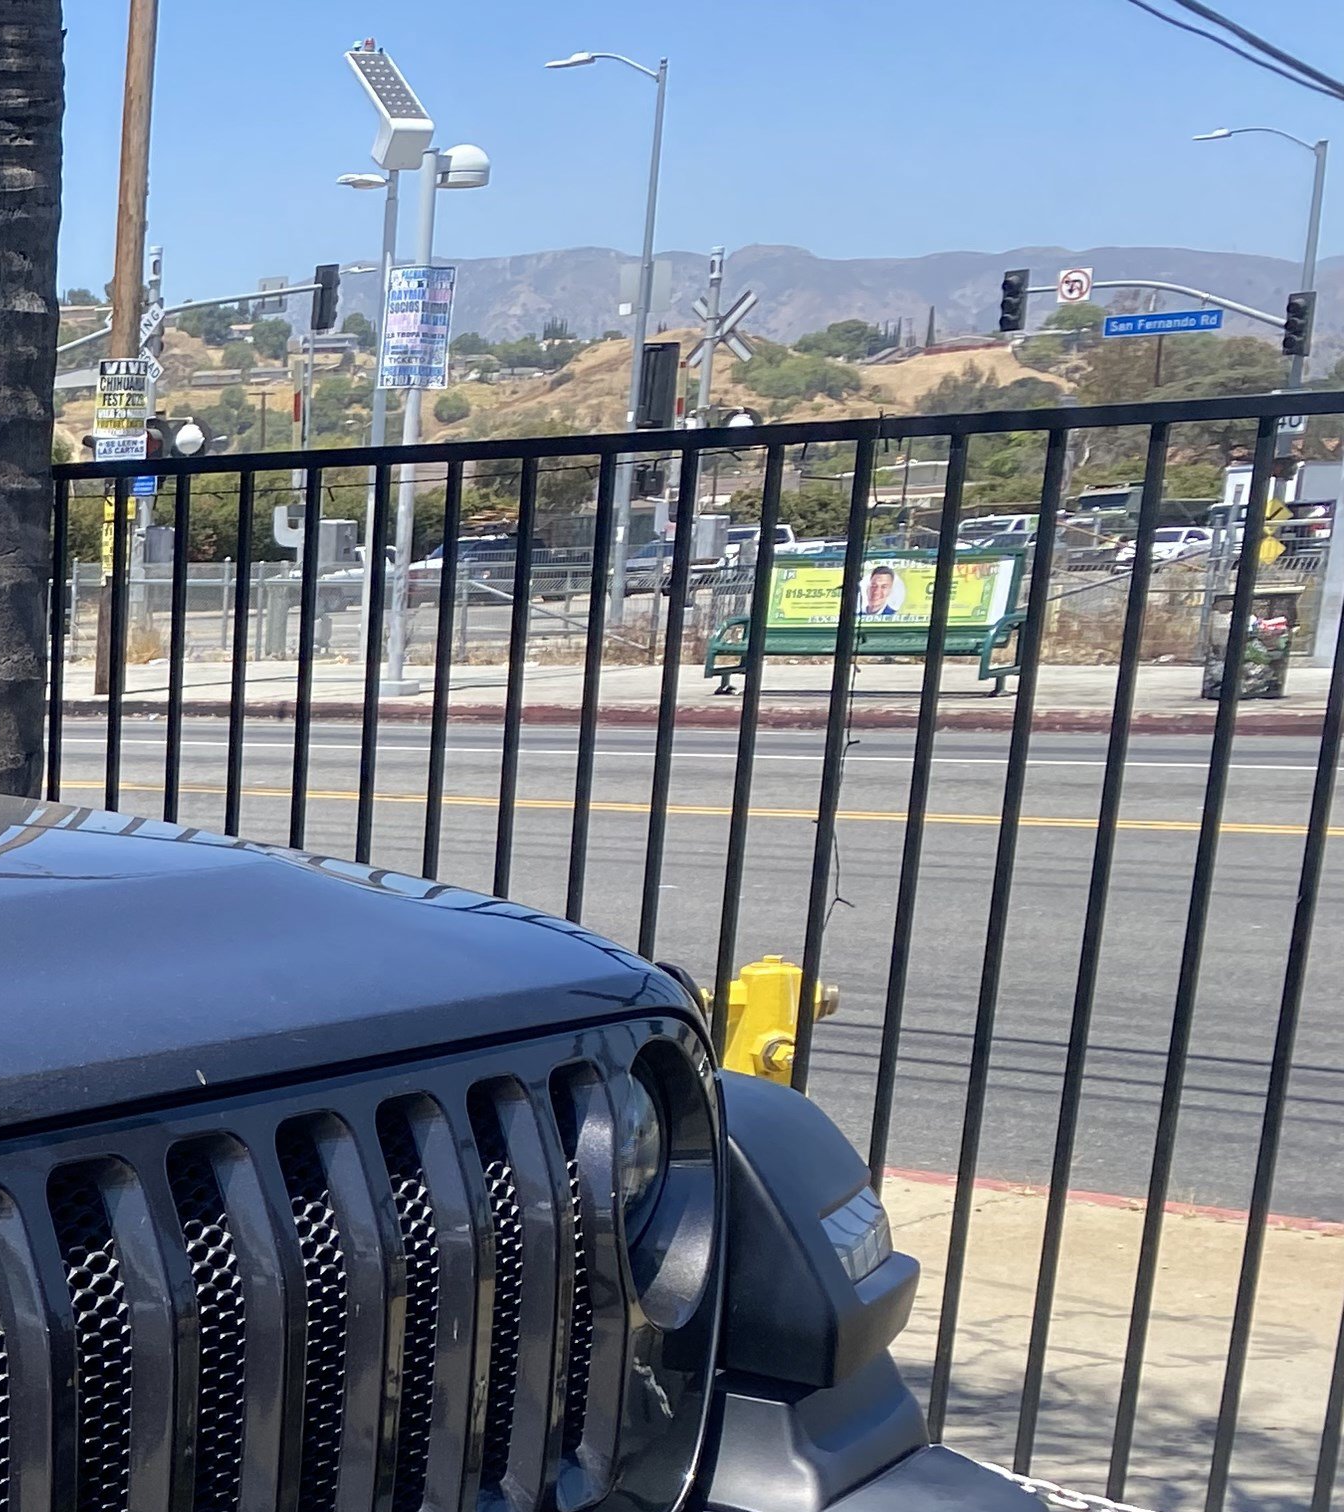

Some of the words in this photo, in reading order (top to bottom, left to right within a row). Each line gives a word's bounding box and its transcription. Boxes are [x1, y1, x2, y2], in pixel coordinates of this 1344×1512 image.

[389, 301, 419, 313] SOCIOS
[1110, 320, 1133, 332] San
[1137, 316, 1196, 330] Fernando
[1200, 314, 1217, 325] Rd
[102, 393, 125, 407] FEST
[97, 447, 113, 455] LAS
[114, 445, 145, 455] CARTAS
